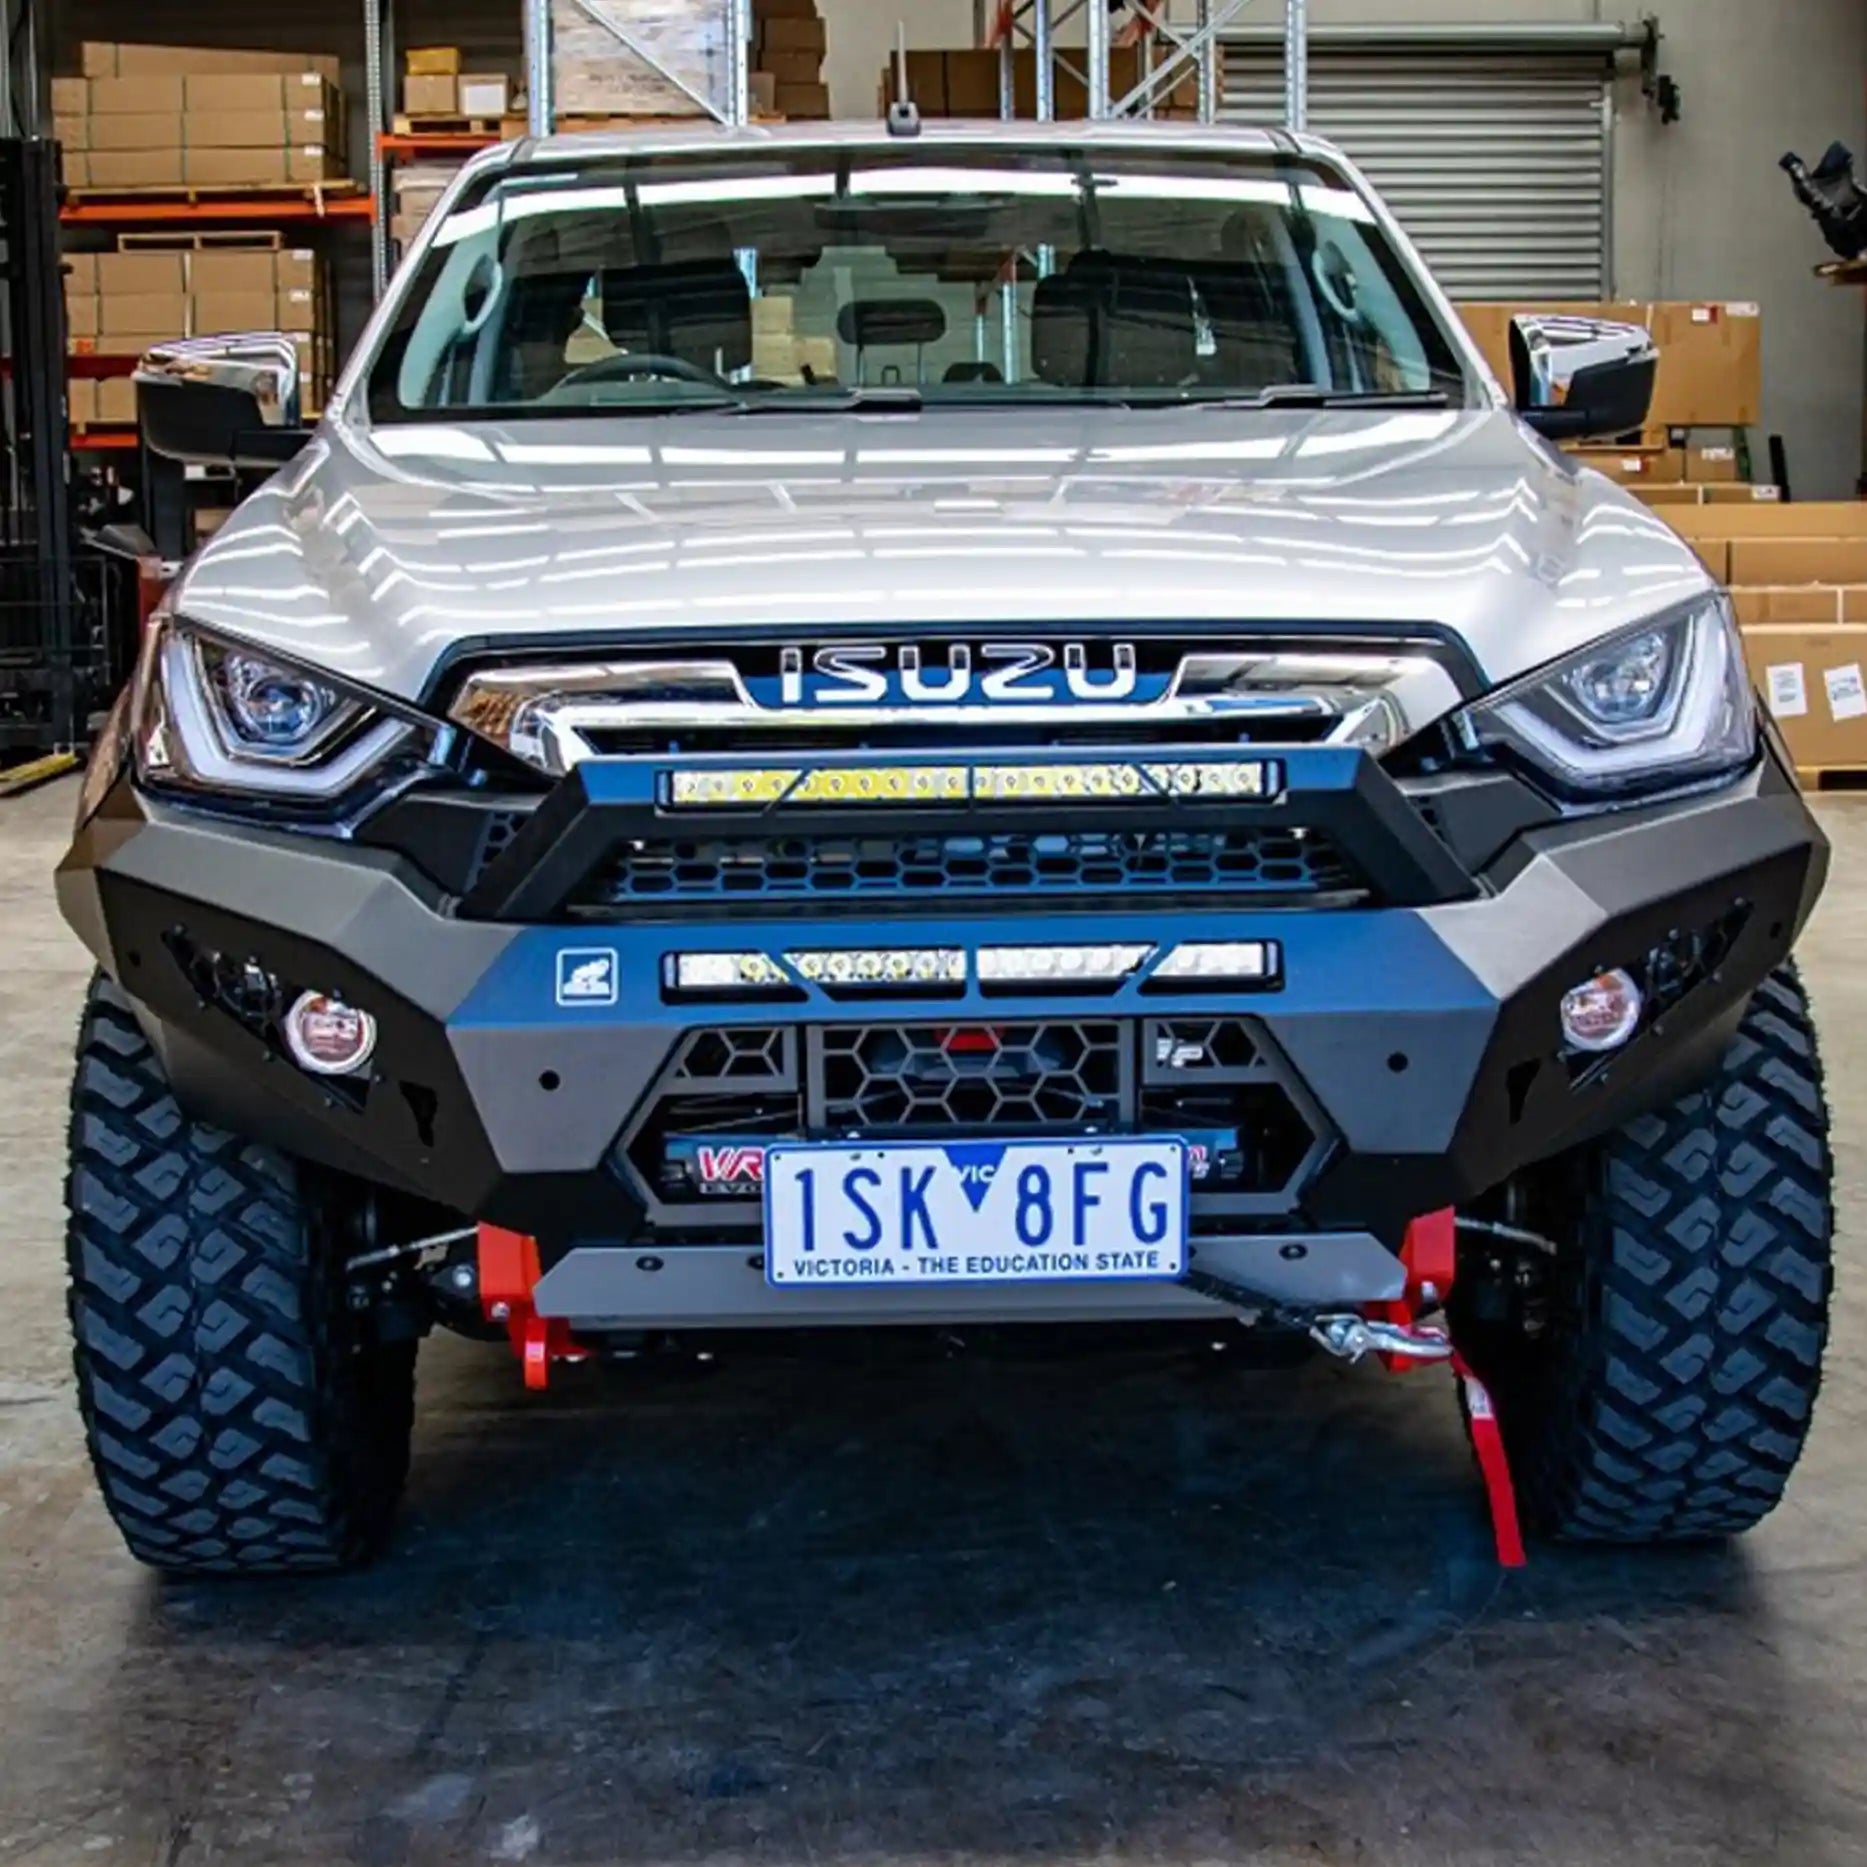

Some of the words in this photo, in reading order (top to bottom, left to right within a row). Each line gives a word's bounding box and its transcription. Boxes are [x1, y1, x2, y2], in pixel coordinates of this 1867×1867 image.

[780, 643, 1136, 702] ISUZU
[954, 1164, 996, 1184] VIC
[794, 1166, 939, 1252] 1SK
[1015, 1161, 1168, 1247] 8FG
[794, 1258, 895, 1277] VICTORIA
[917, 1255, 960, 1274] THE
[966, 1252, 1089, 1274] EDUCATION
[1095, 1250, 1160, 1271] STATE
